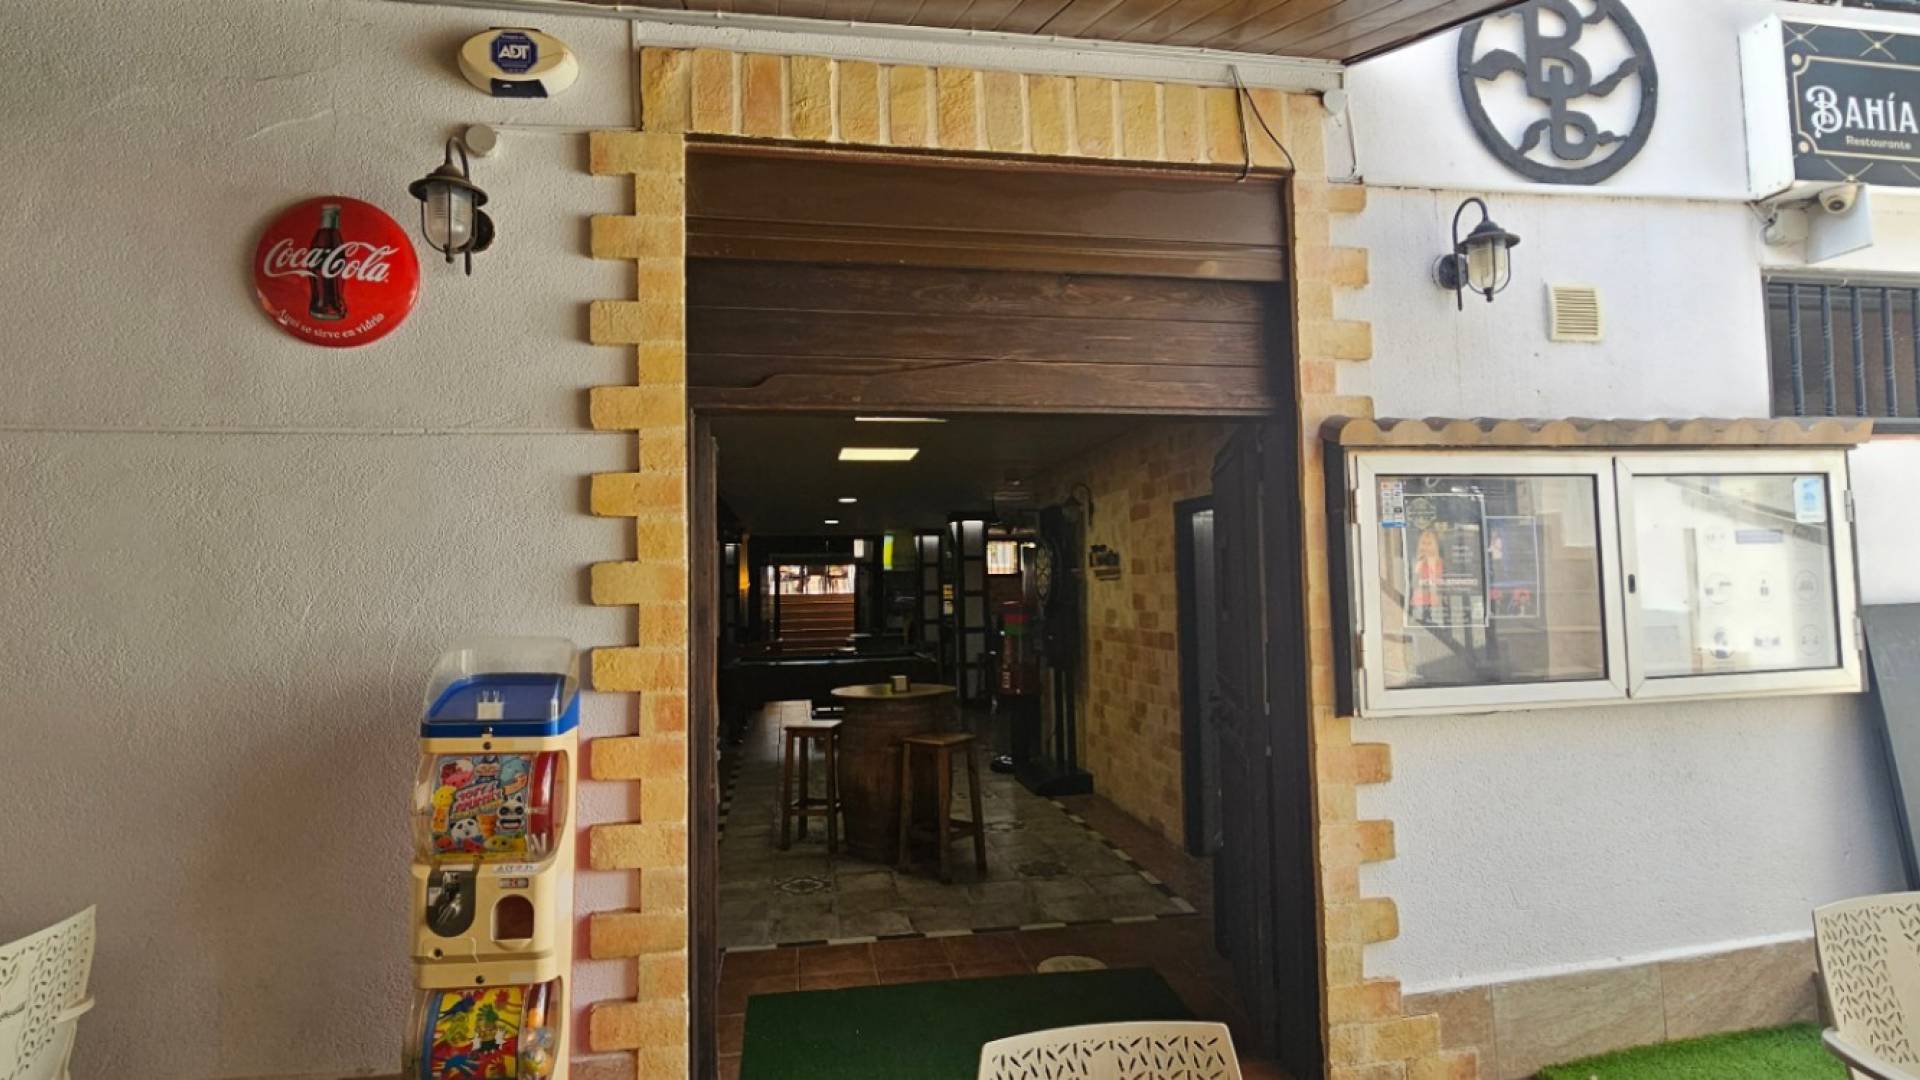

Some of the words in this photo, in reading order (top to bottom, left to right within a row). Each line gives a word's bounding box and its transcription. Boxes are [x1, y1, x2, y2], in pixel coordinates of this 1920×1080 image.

[498, 44, 530, 60] ADT
[1846, 135, 1912, 150] Restaurante
[264, 238, 398, 282] Coca-Cola
